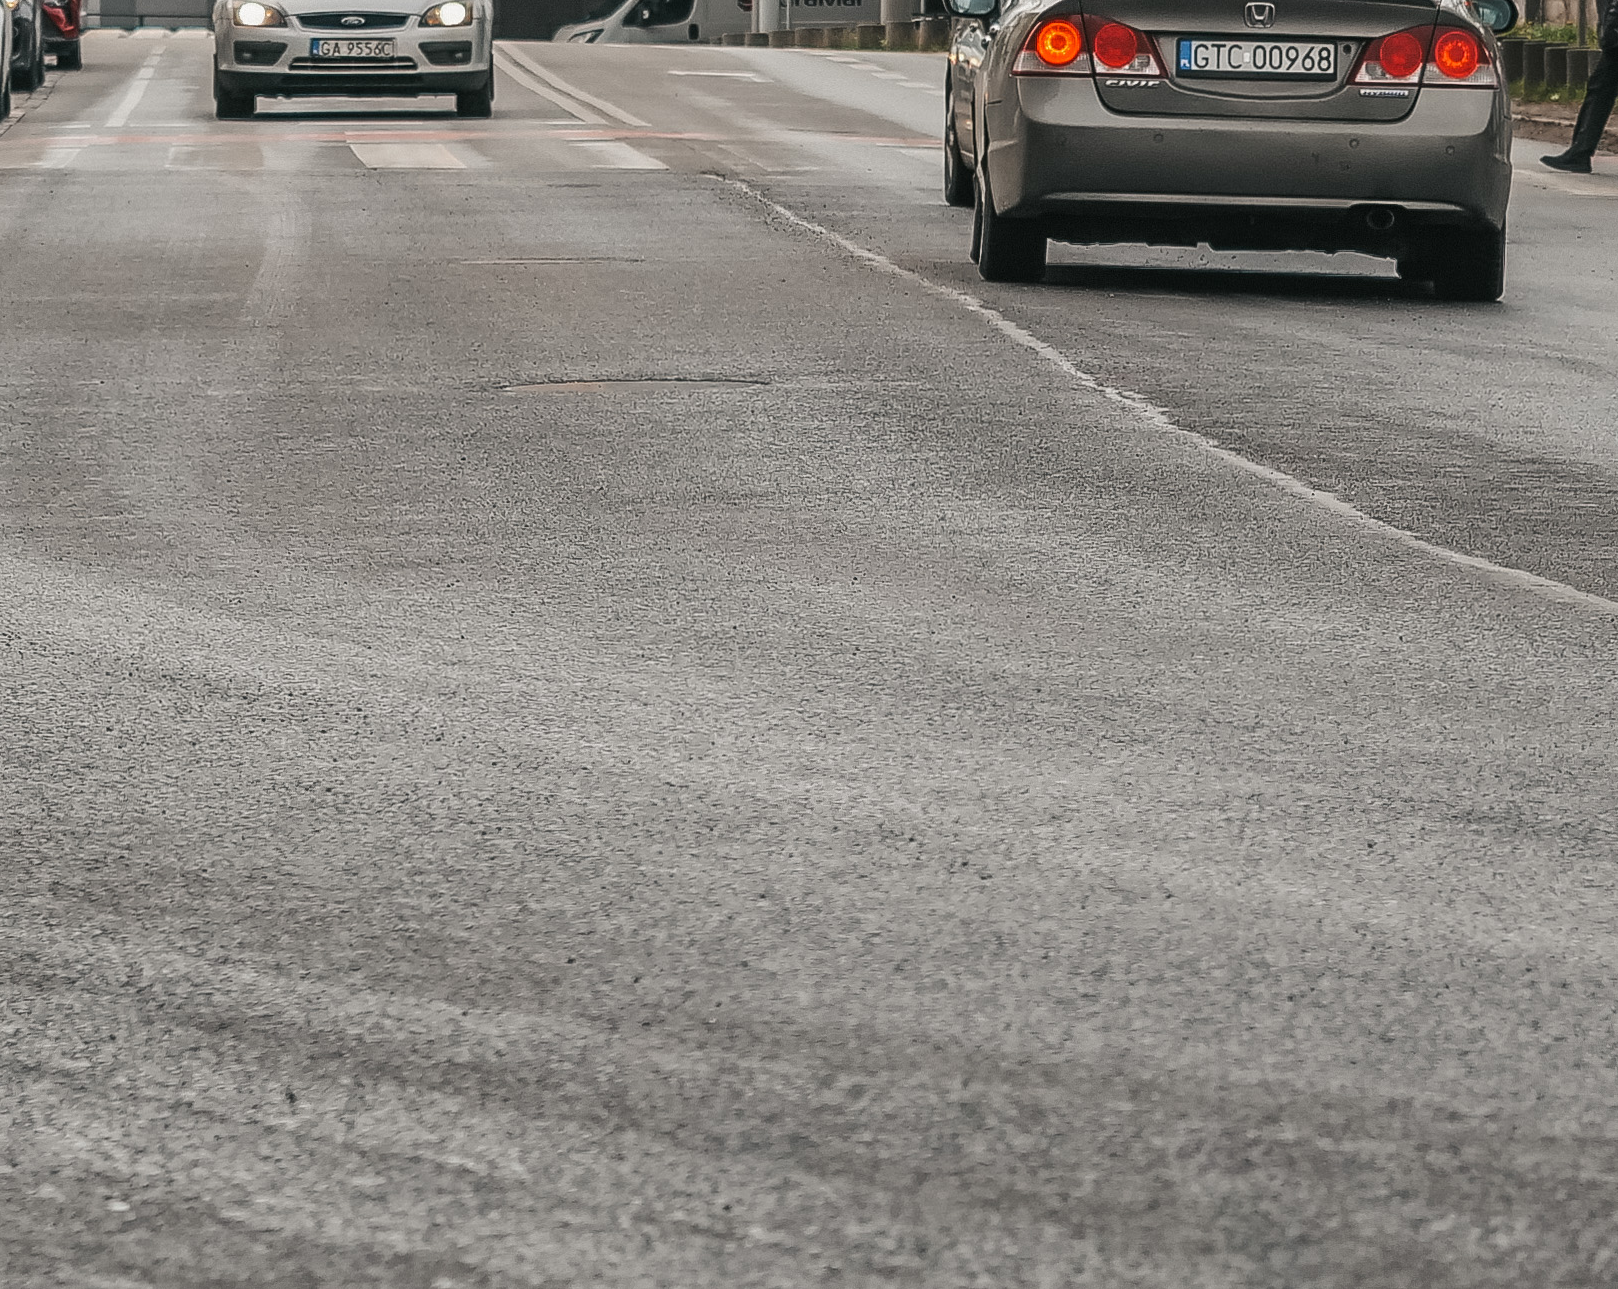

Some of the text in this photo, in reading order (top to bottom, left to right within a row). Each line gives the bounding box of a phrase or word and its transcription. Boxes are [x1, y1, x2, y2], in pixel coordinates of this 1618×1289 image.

[321, 41, 341, 56] GA
[1194, 43, 1243, 70] GTC
[1253, 44, 1332, 72] 00968
